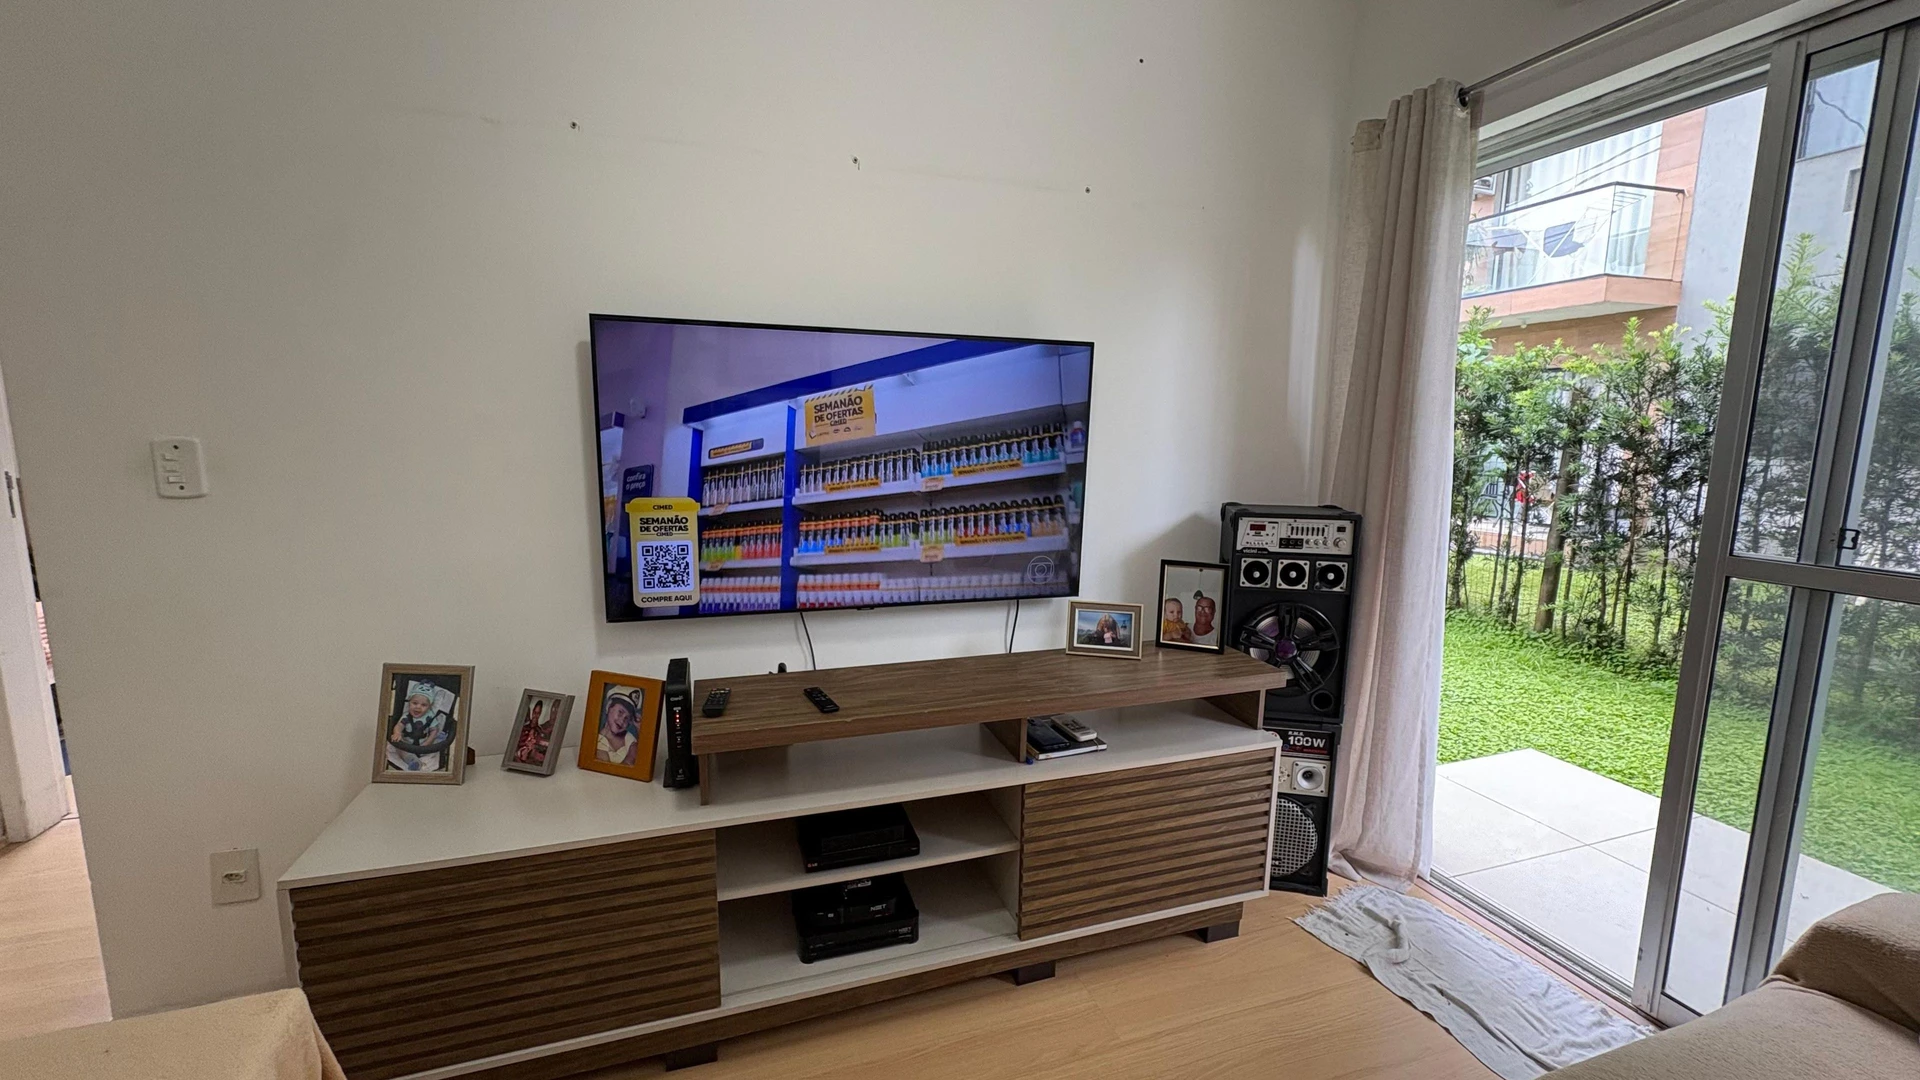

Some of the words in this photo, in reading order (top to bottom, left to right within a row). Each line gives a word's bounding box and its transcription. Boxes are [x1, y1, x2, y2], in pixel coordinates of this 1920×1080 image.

[813, 394, 863, 414] SEMANÃO
[814, 413, 825, 423] DE
[826, 406, 864, 421] OFERTAS
[626, 472, 646, 482] confira
[630, 481, 646, 491] preço
[639, 514, 689, 525] SEMANÃO
[652, 525, 689, 533] OFERTAS
[641, 595, 673, 603] COMPRE
[674, 594, 693, 602] AQUI
[1288, 735, 1326, 748] 100W
